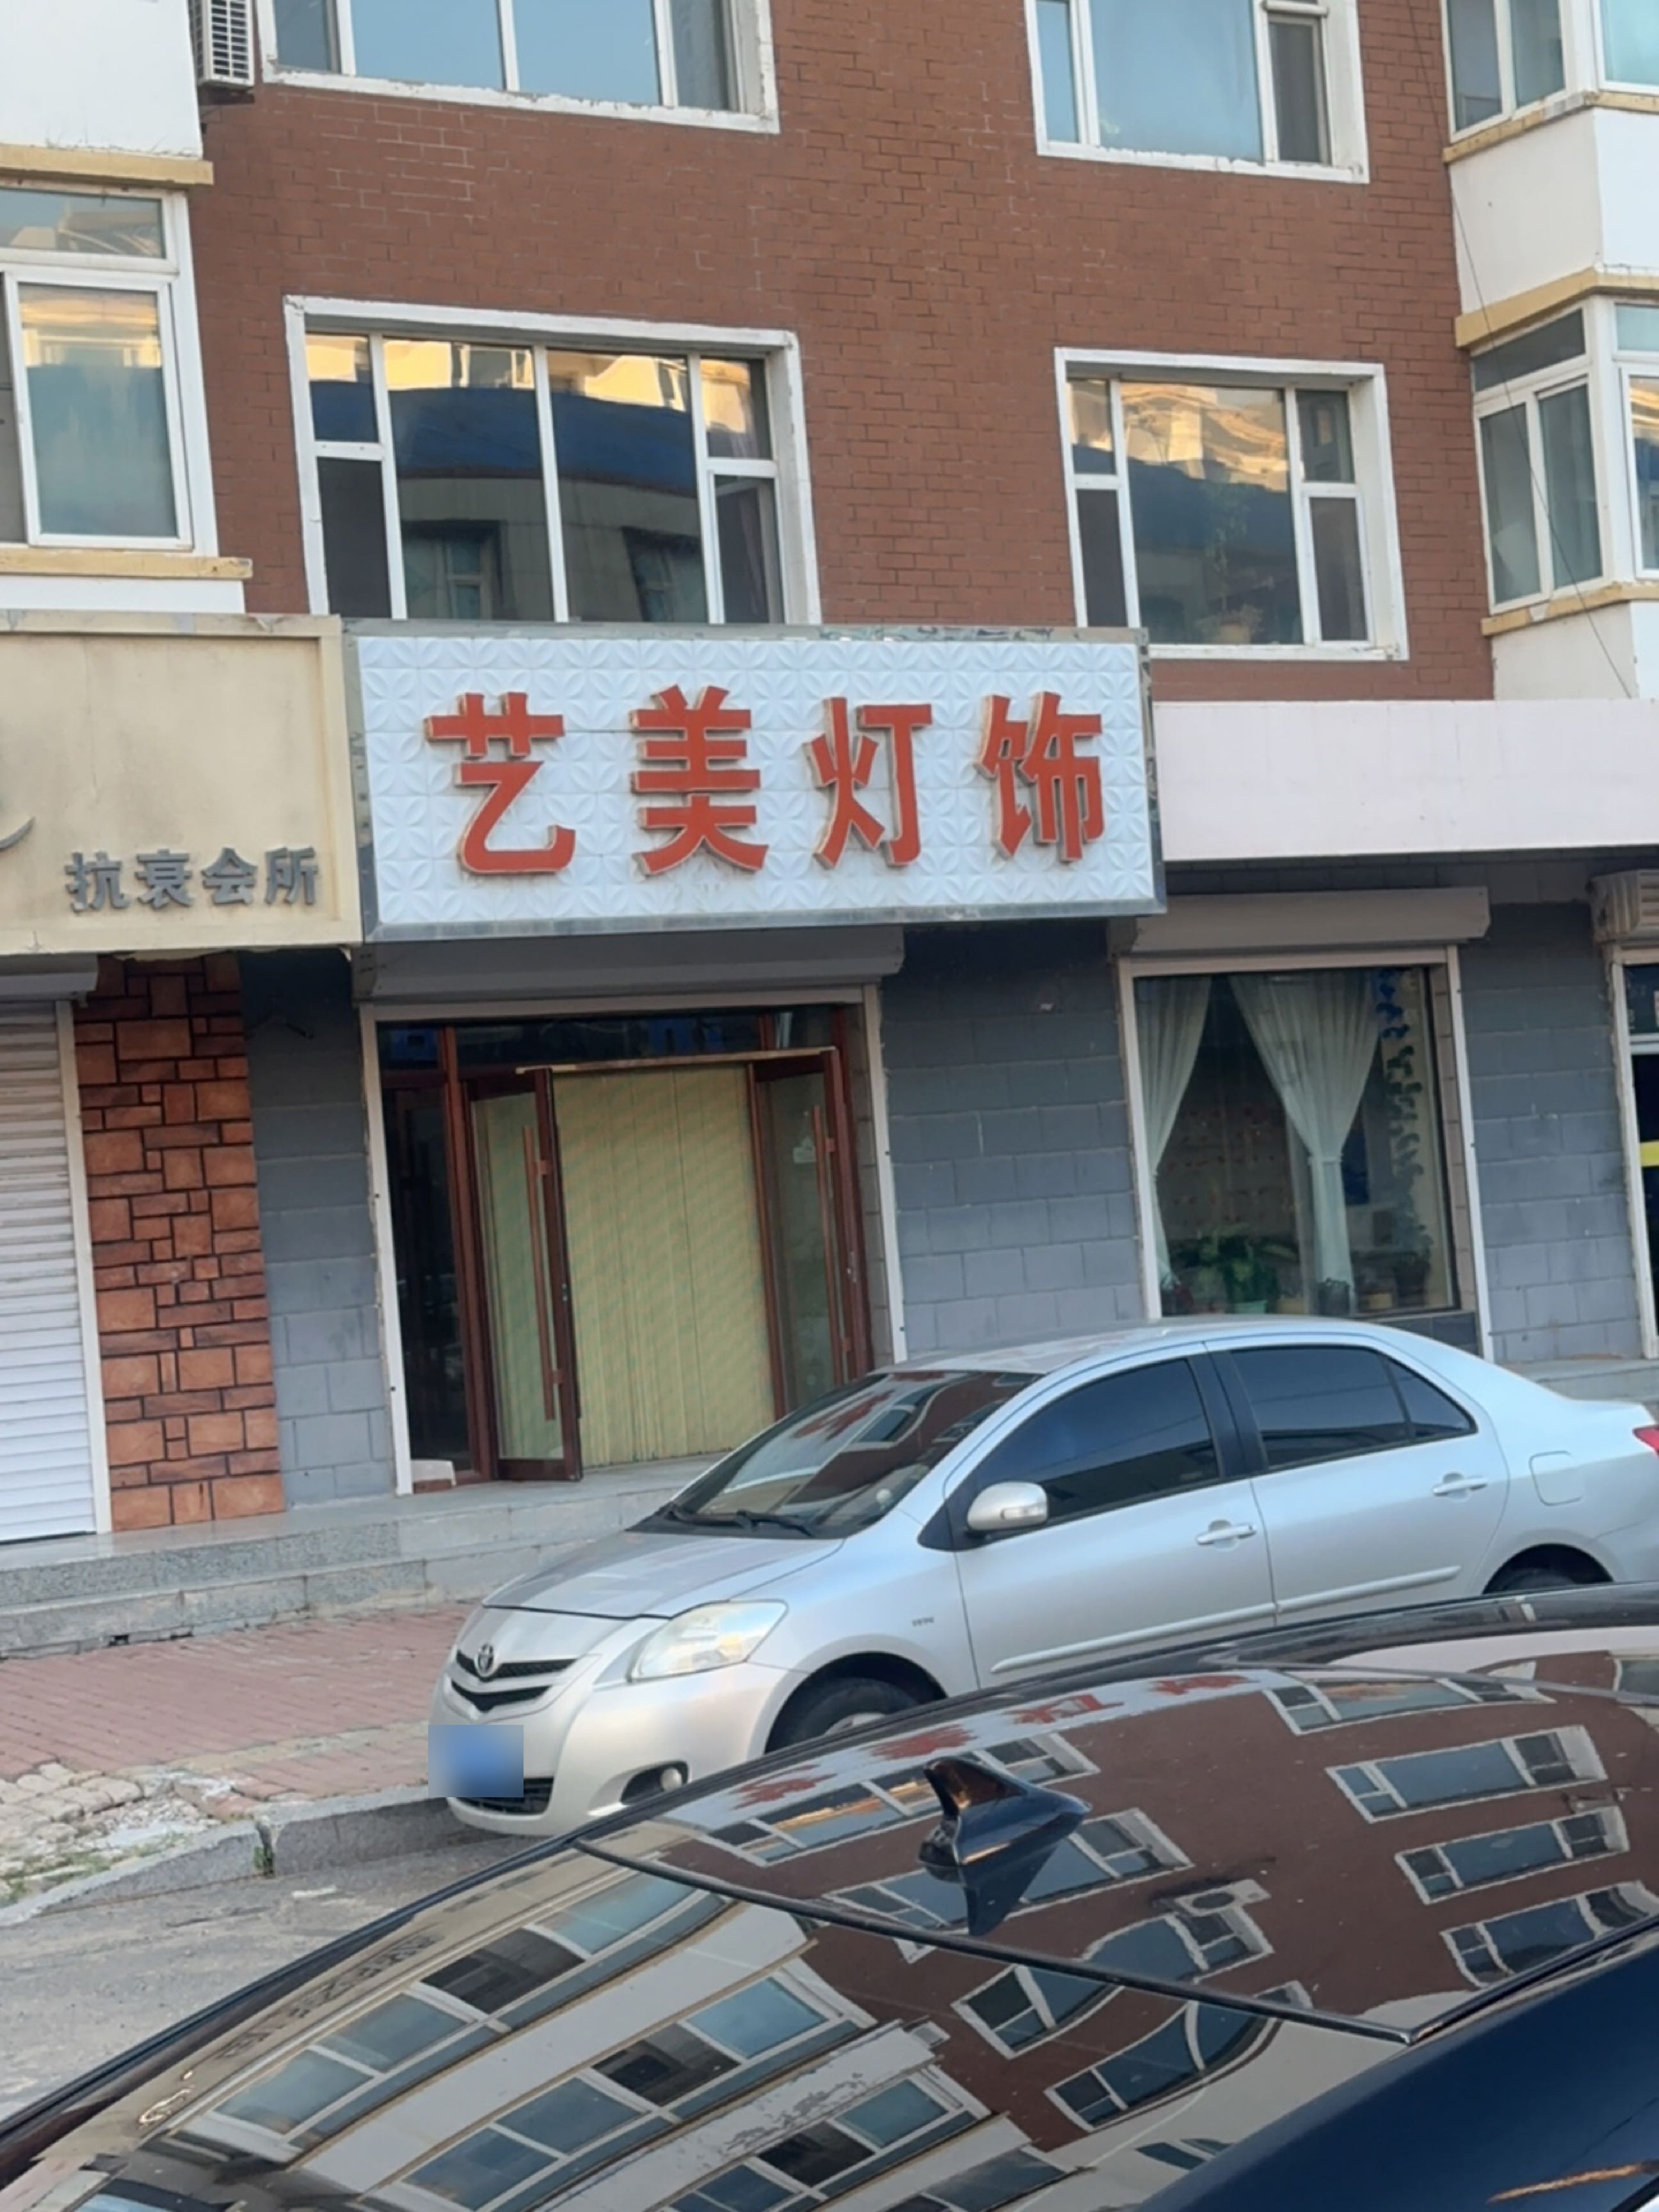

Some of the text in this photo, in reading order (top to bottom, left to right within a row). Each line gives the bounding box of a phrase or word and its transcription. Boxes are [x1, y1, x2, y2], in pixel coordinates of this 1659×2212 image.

[424, 684, 1105, 876] 艺美灯饰
[64, 846, 319, 913] 抗衰会所
